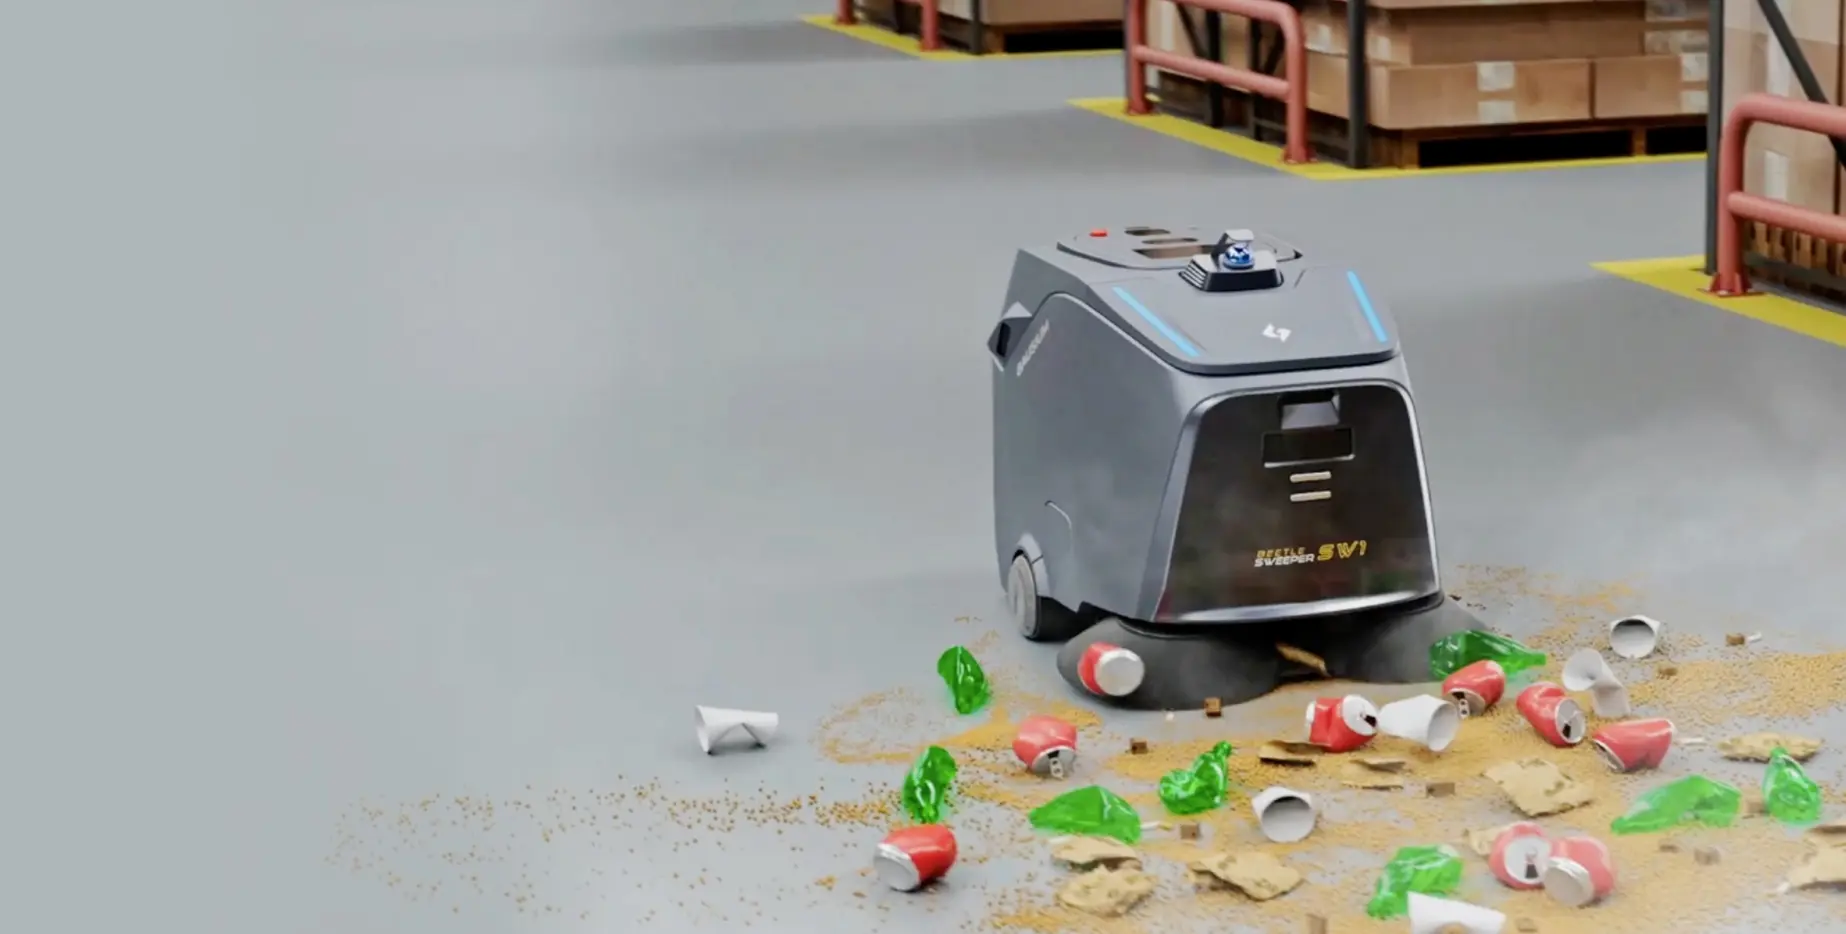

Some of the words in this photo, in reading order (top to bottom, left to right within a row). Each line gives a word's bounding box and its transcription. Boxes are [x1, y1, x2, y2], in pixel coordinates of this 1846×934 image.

[1256, 547, 1306, 558] BEETLE
[1317, 540, 1367, 561] SW1
[1254, 553, 1316, 567] SWEEPER
